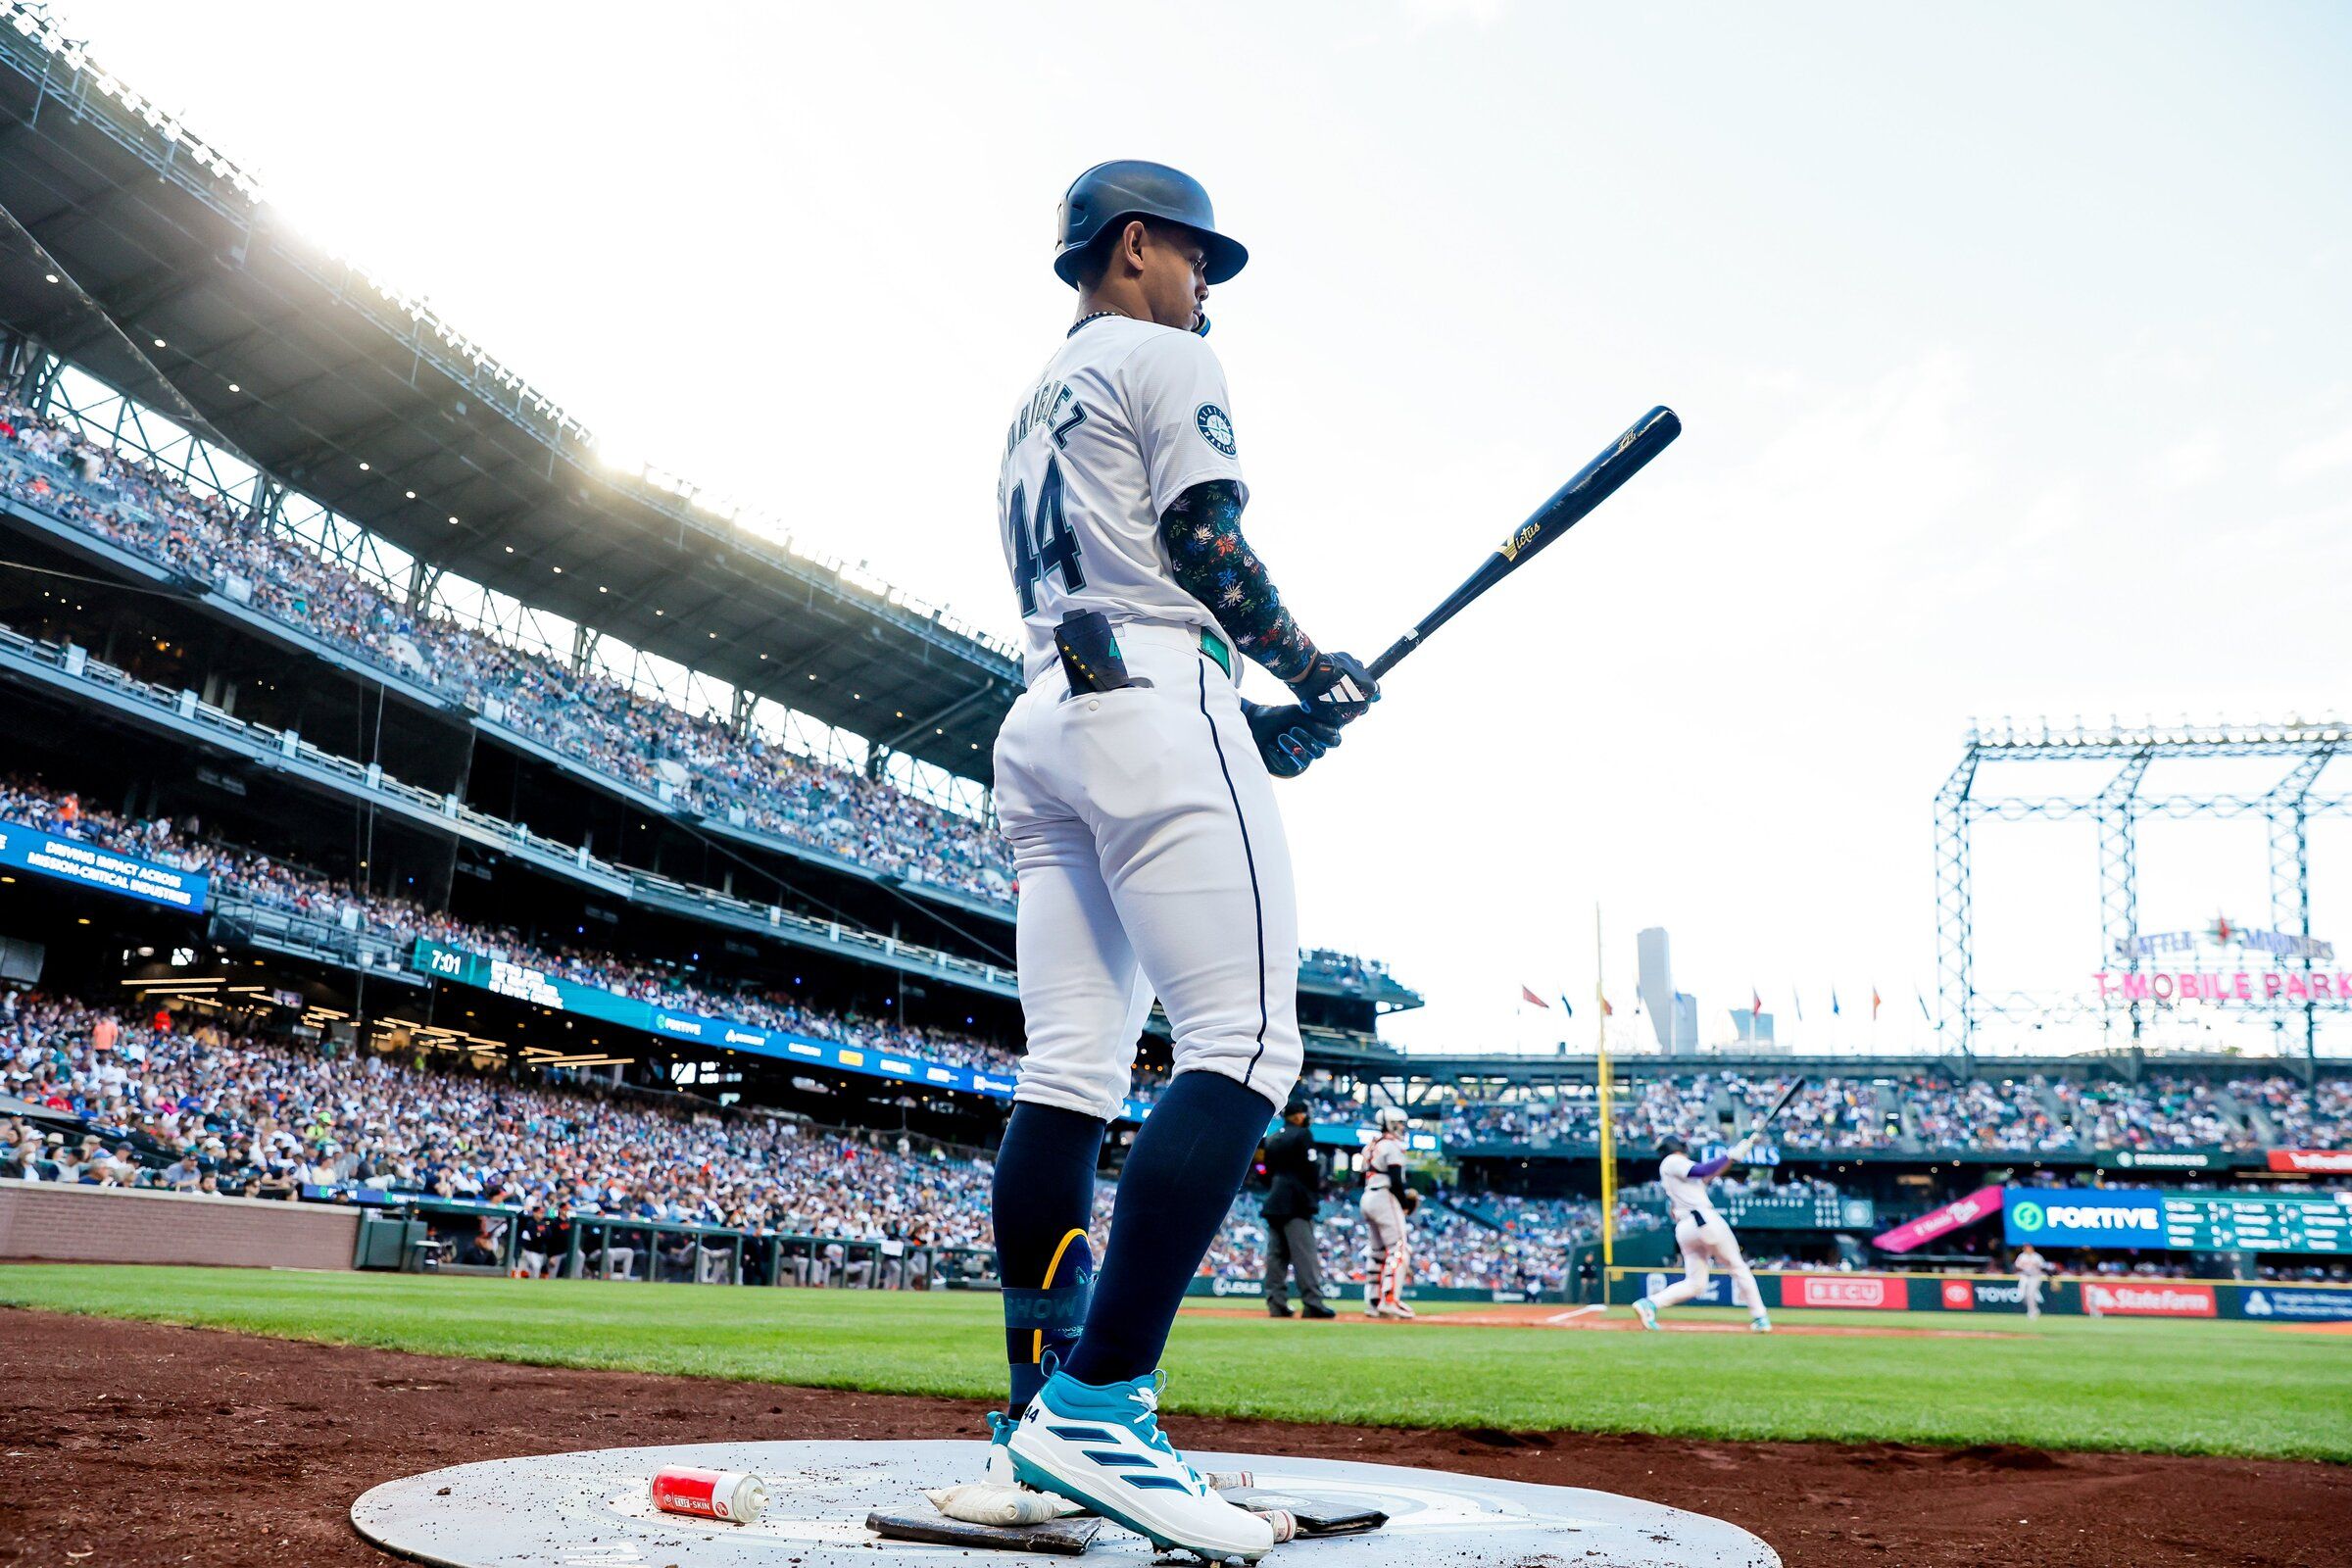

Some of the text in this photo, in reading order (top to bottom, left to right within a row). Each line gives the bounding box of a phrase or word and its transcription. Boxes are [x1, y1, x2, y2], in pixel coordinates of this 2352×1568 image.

[1007, 448, 1088, 619] 44
[45, 841, 182, 889] DRIVING IMPACT ACROSS
[431, 949, 462, 975] 7:01
[2092, 973, 2352, 1001] T-MOBILE PARK
[2045, 1205, 2160, 1230] FORTIVE
[1813, 1283, 1859, 1301] BECU
[1975, 1287, 2044, 1303] TOYO
[1023, 1405, 1040, 1424] 44
[674, 1496, 710, 1510] TUF-SKIN
